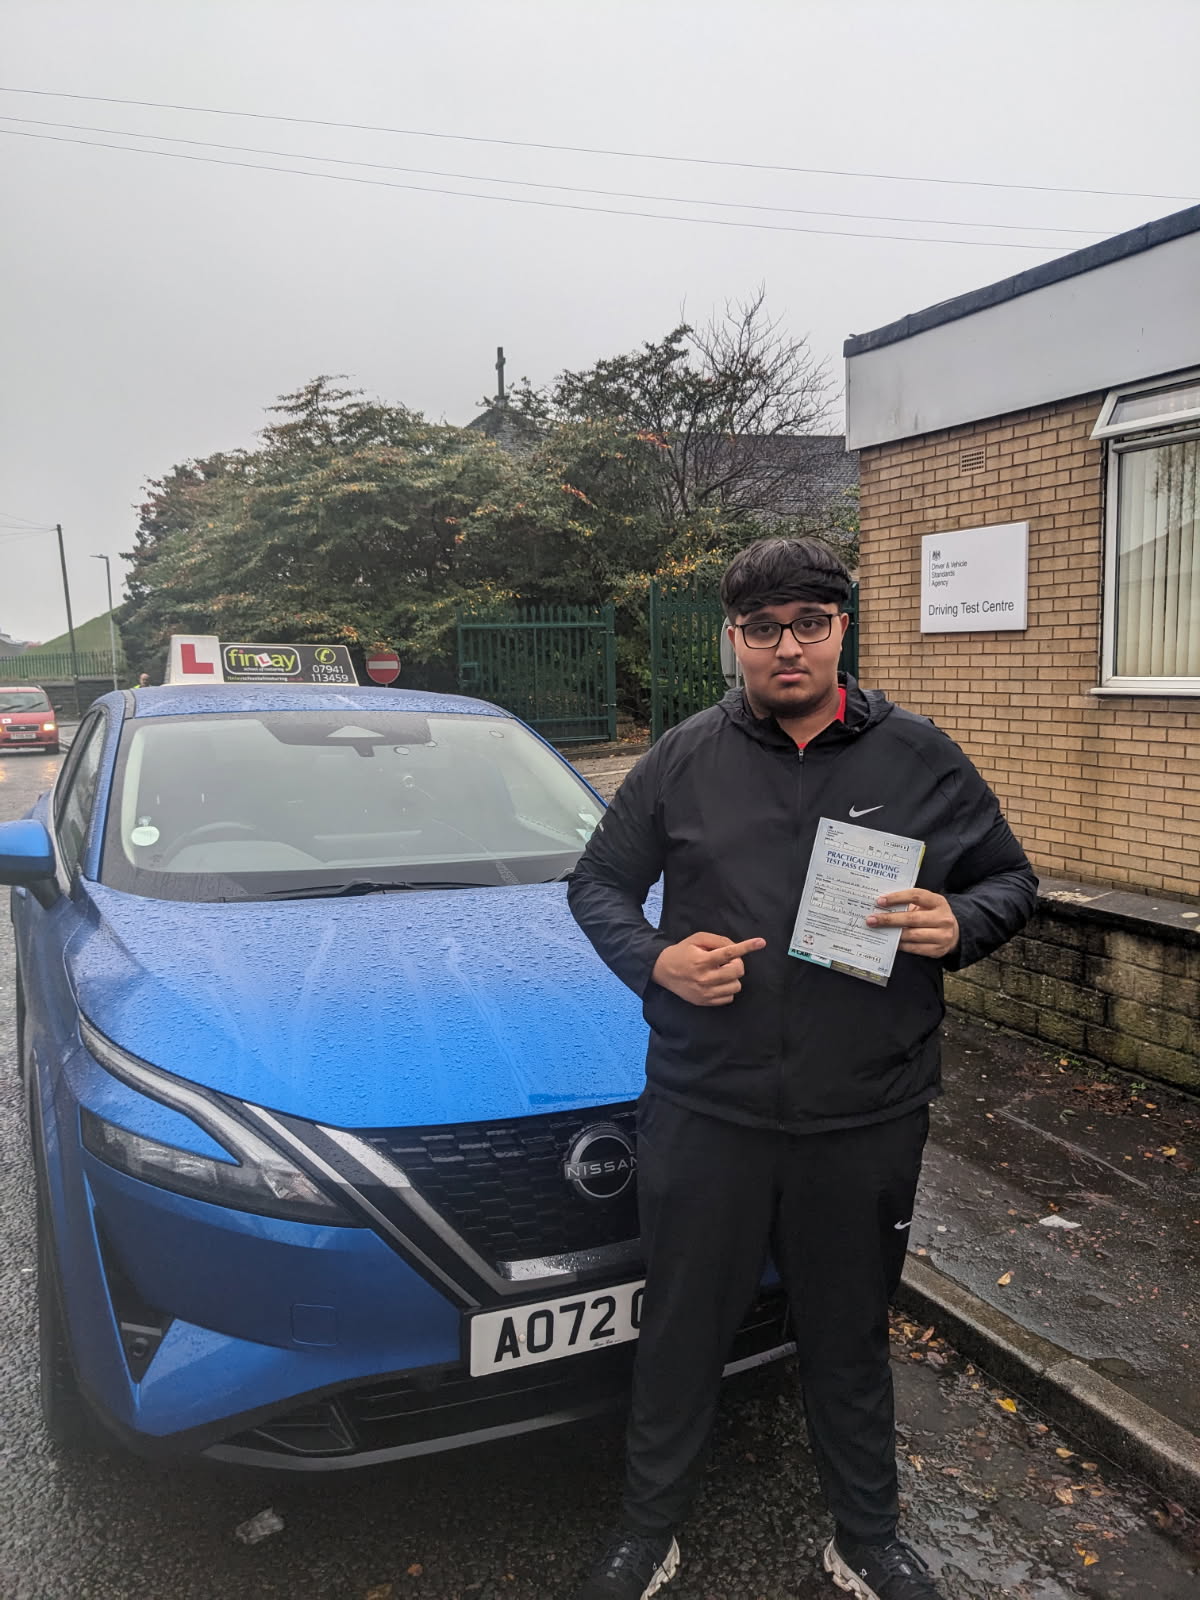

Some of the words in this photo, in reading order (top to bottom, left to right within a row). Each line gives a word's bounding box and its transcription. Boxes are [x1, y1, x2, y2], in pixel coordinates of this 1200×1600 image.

[928, 604, 958, 618] Driving
[960, 602, 980, 614] Test
[982, 600, 1015, 613] Centre
[181, 644, 214, 674] L
[312, 664, 344, 674] 07941
[311, 673, 349, 683] 113459
[826, 856, 841, 866] TEST
[841, 860, 857, 870] PASS
[858, 865, 898, 881] CERTIFICATE
[827, 850, 865, 866] PRACTICAL
[867, 860, 900, 874] DRIVING
